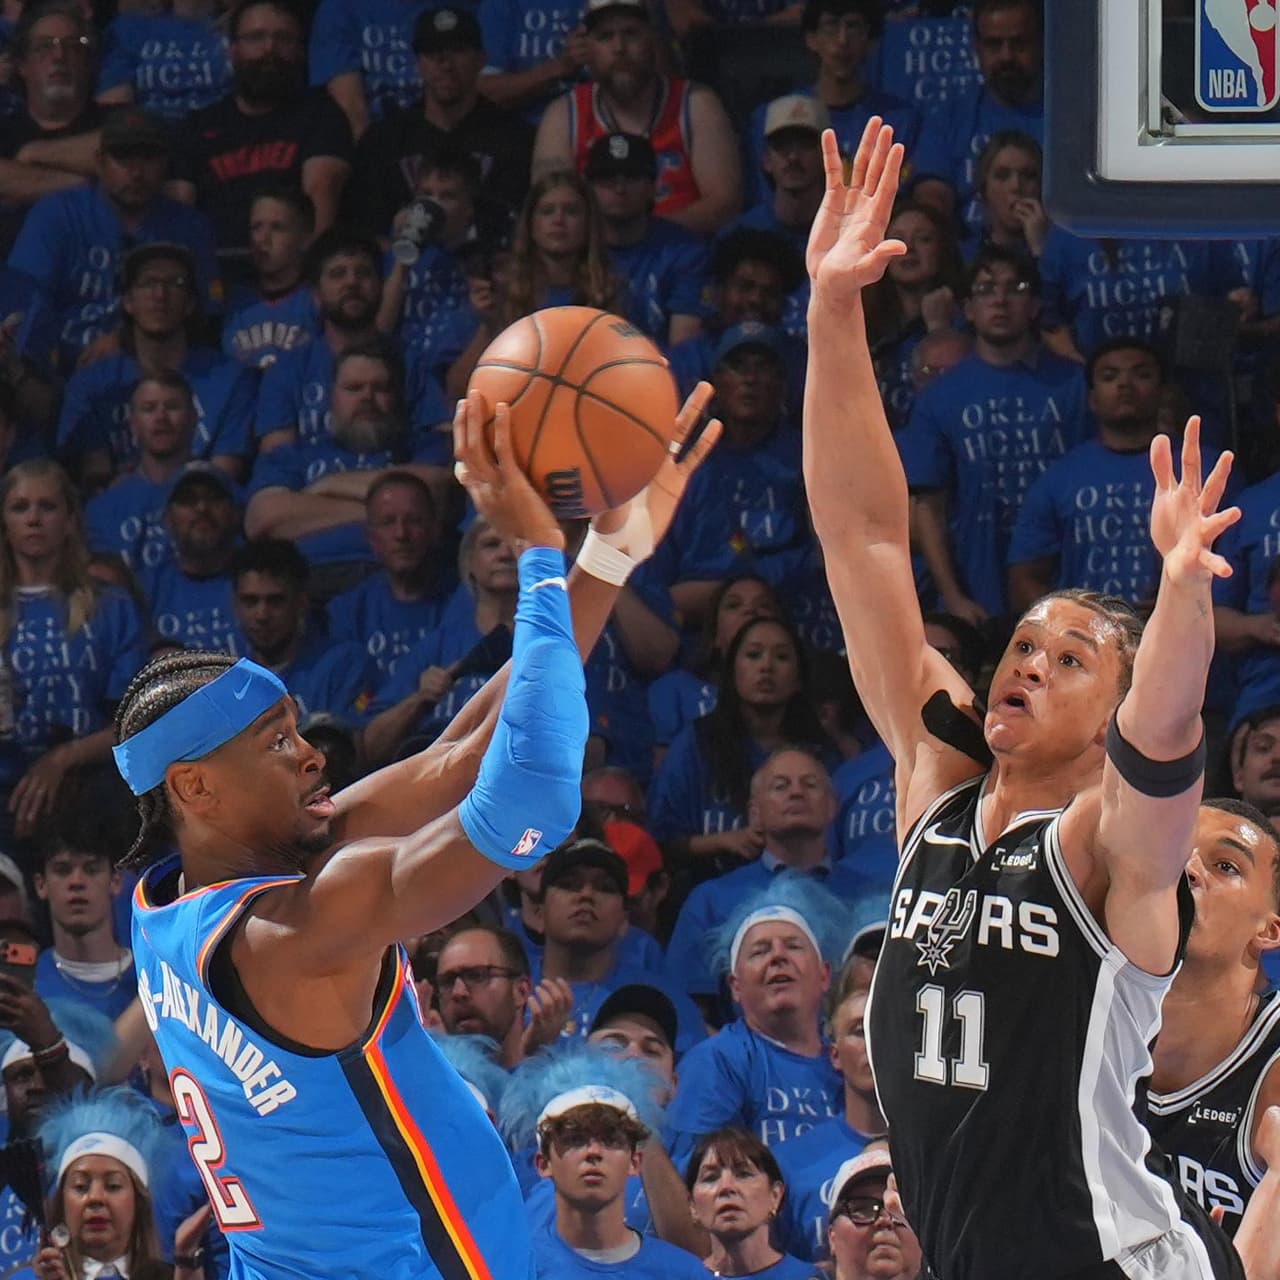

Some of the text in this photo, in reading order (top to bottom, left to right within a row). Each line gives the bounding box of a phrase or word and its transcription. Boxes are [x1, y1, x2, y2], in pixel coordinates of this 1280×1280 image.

[524, 9, 572, 32] OK
[362, 25, 407, 49] OK
[521, 34, 564, 58] HO
[363, 50, 407, 73] HO
[905, 50, 979, 73] HOM
[1208, 69, 1248, 99] NBA
[962, 397, 1064, 429] OKLA
[1075, 482, 1151, 510] OKL
[121, 512, 165, 540] OK
[1074, 511, 1151, 544] HOM
[1087, 547, 1148, 574] CIT
[16, 619, 94, 641] KLA
[158, 612, 222, 636] OKL
[12, 645, 98, 671] OMA
[890, 887, 1061, 958] SPURS
[914, 984, 989, 1091] 11
[767, 1087, 834, 1117] OKL
[761, 1120, 816, 1146] HO
[170, 1067, 264, 1232] 2
